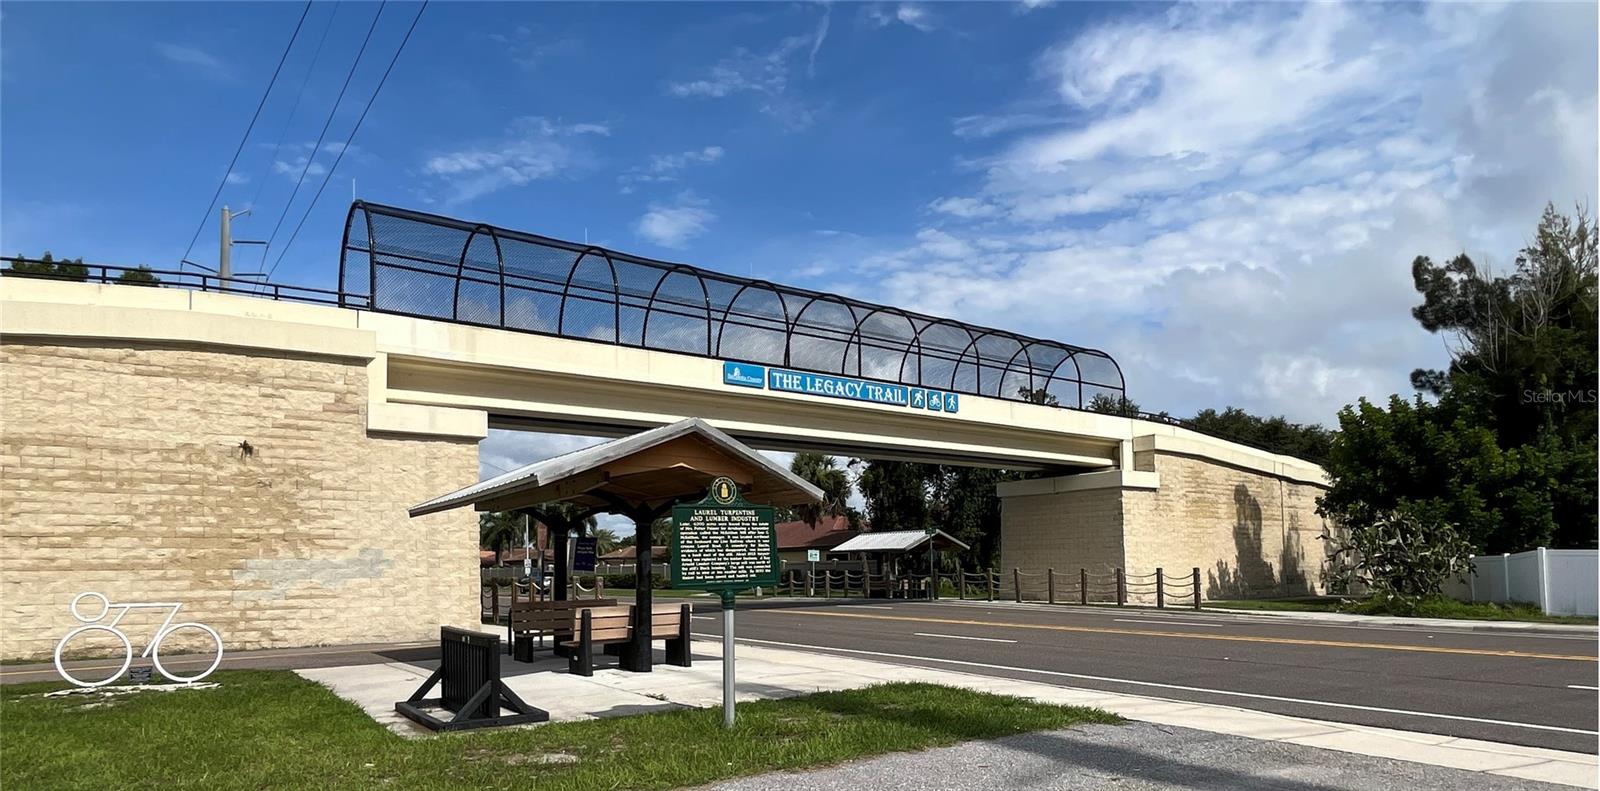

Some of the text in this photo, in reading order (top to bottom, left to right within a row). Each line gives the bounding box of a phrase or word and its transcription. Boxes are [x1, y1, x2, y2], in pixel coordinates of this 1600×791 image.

[772, 372, 906, 403] THE LEGACY TRAIL
